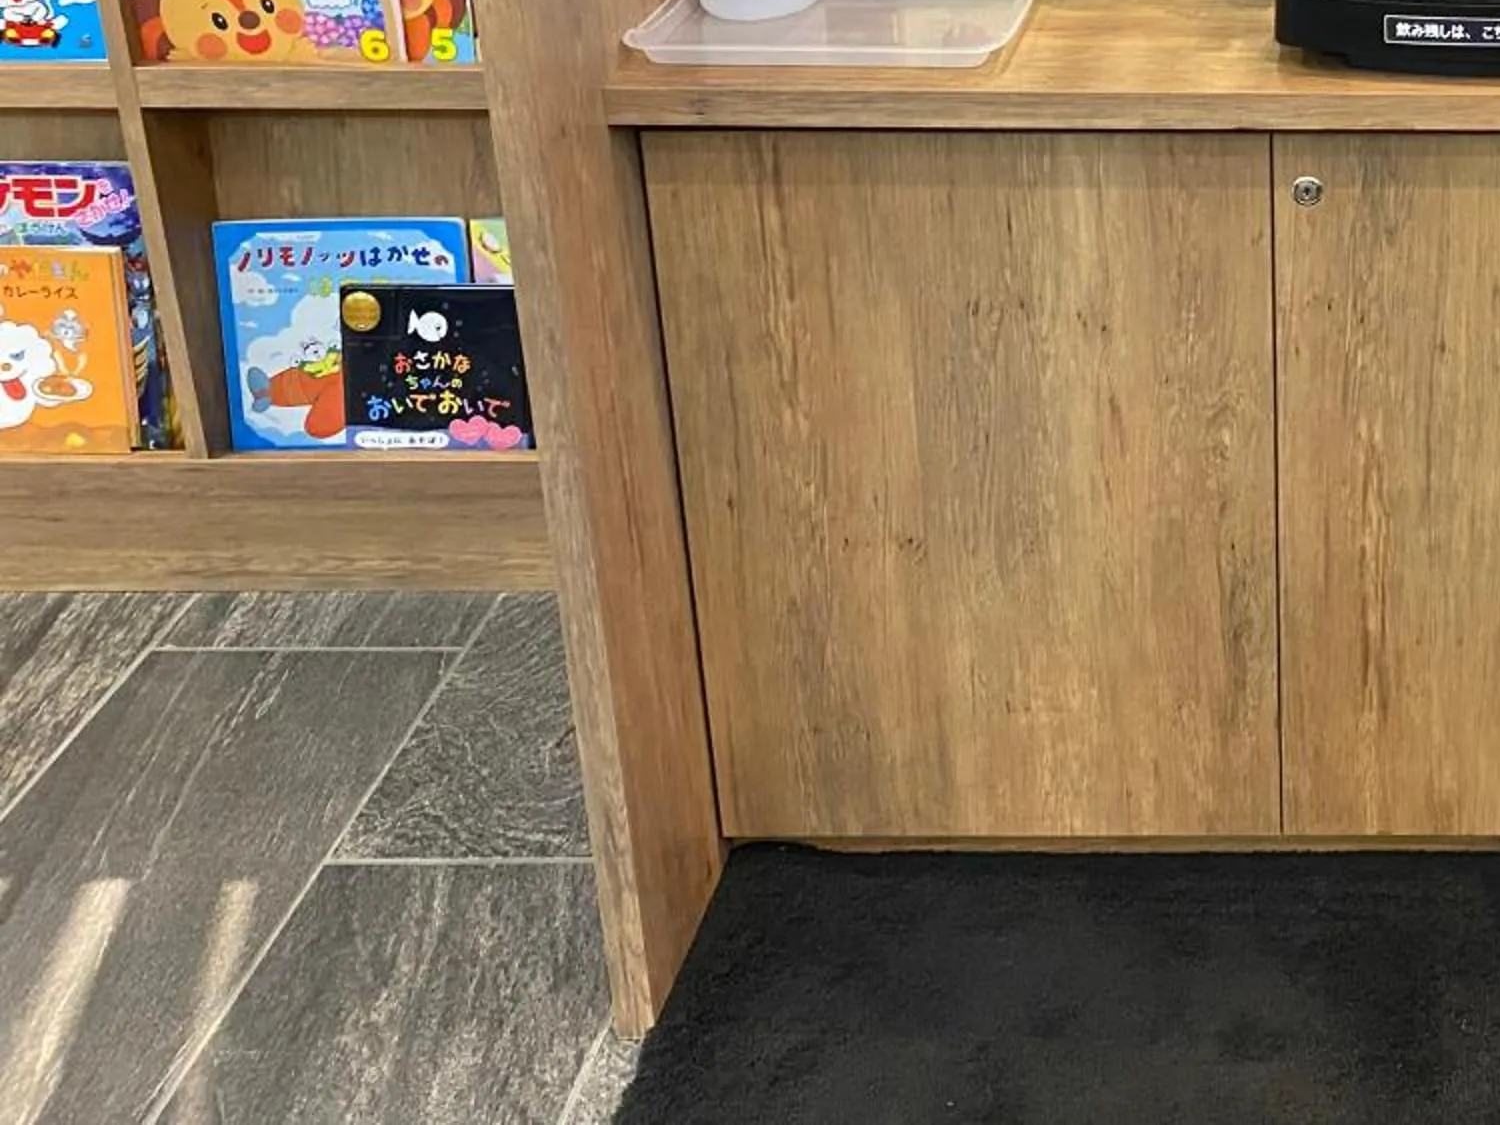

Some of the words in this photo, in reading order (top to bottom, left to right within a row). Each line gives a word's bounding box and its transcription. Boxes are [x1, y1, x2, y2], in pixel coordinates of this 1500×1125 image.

[359, 28, 390, 61] 6
[431, 28, 457, 61] 5
[237, 245, 450, 273] ノリモノッツはかせの
[4, 285, 79, 300] カレーライス
[393, 350, 472, 374] おさかな
[405, 374, 463, 390] ちゃんの
[367, 389, 511, 421] おいでおいで
